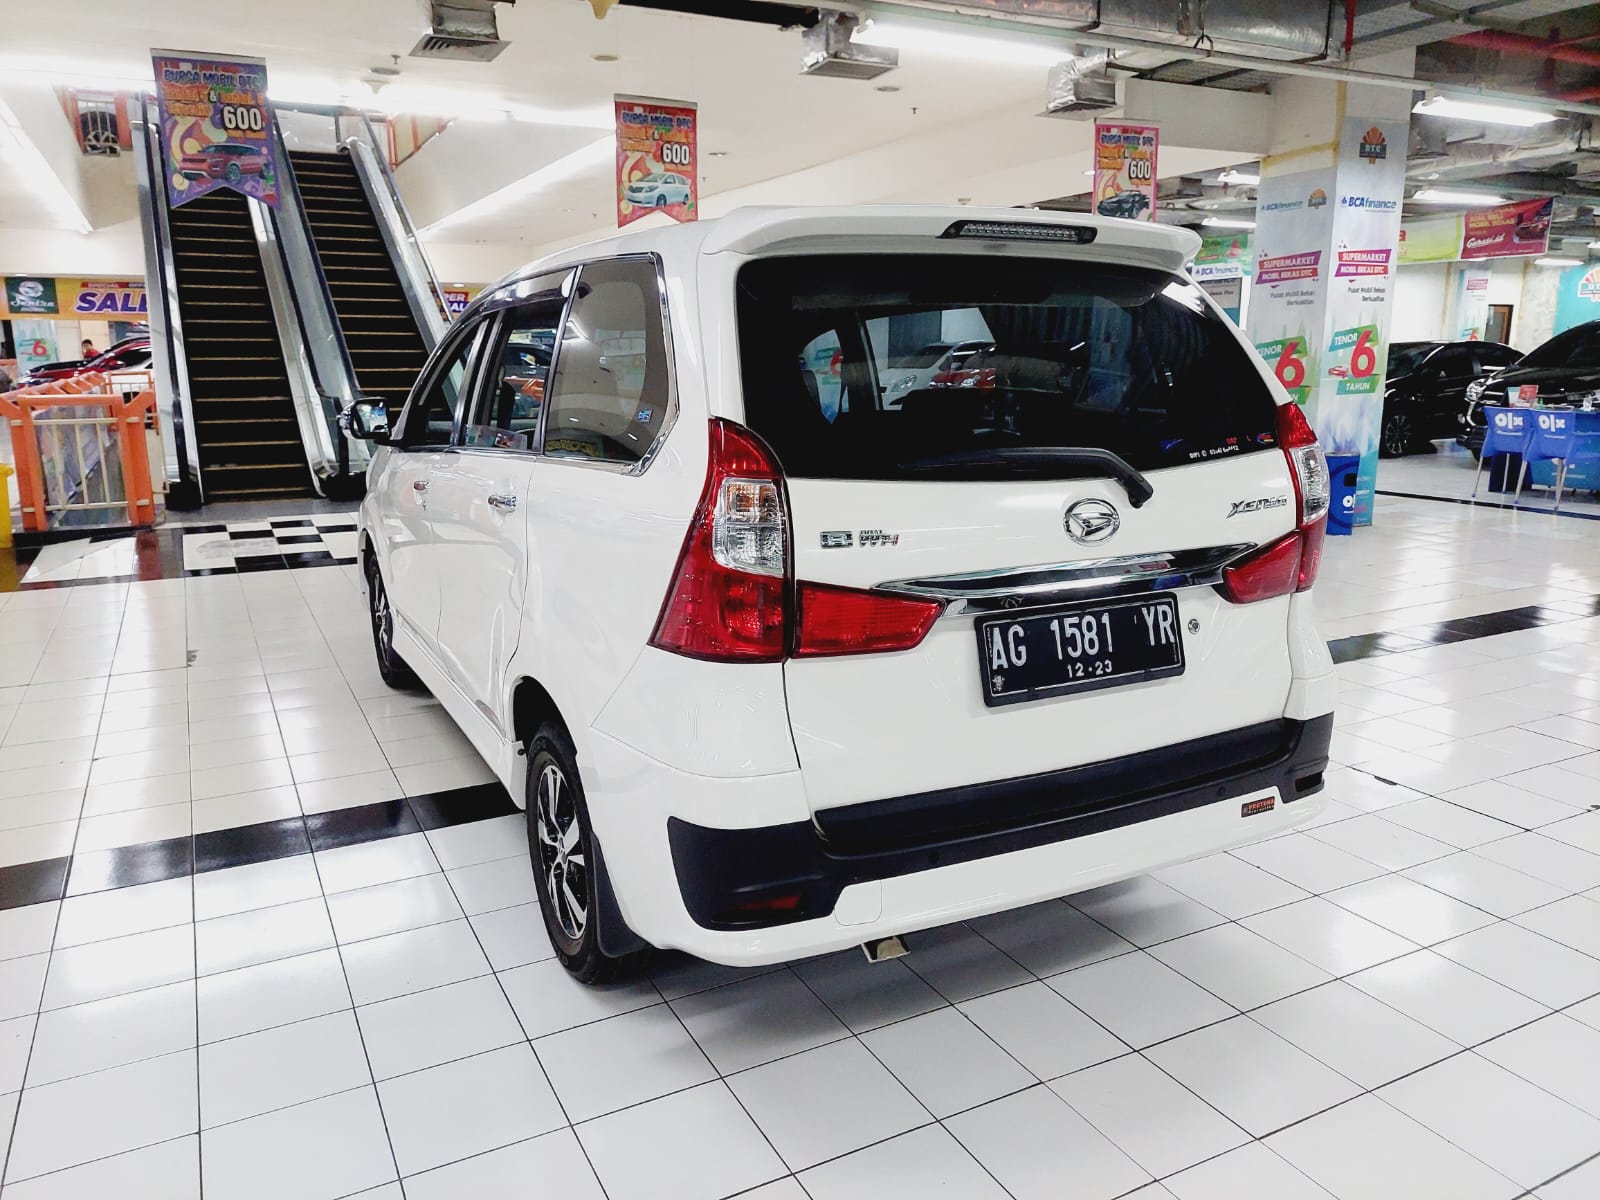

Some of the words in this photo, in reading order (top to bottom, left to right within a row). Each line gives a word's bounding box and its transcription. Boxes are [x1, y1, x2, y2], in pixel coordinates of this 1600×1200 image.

[164, 69, 200, 83] BURSA
[203, 73, 235, 86] MOBIL
[223, 106, 262, 131] 600
[662, 143, 690, 164] 600
[1129, 160, 1151, 179] 600
[1263, 256, 1316, 269] SUPERMARKET
[1343, 252, 1387, 262] SUPERMARKET
[1262, 272, 1281, 281] MOBIL
[1281, 270, 1300, 279] BEKAS
[1301, 268, 1314, 277] DTC
[1340, 265, 1358, 274] MOBIL
[1334, 332, 1358, 345] TENOR
[32, 340, 48, 356] 6
[1350, 329, 1376, 379] 6
[1274, 341, 1305, 389] 6
[1345, 382, 1371, 391] TAHUN
[1494, 412, 1524, 429] olx
[1538, 414, 1566, 432] olx
[1342, 493, 1357, 508] ol
[992, 624, 1027, 670] AG
[1050, 612, 1113, 660] 1581
[1141, 604, 1176, 647] YR
